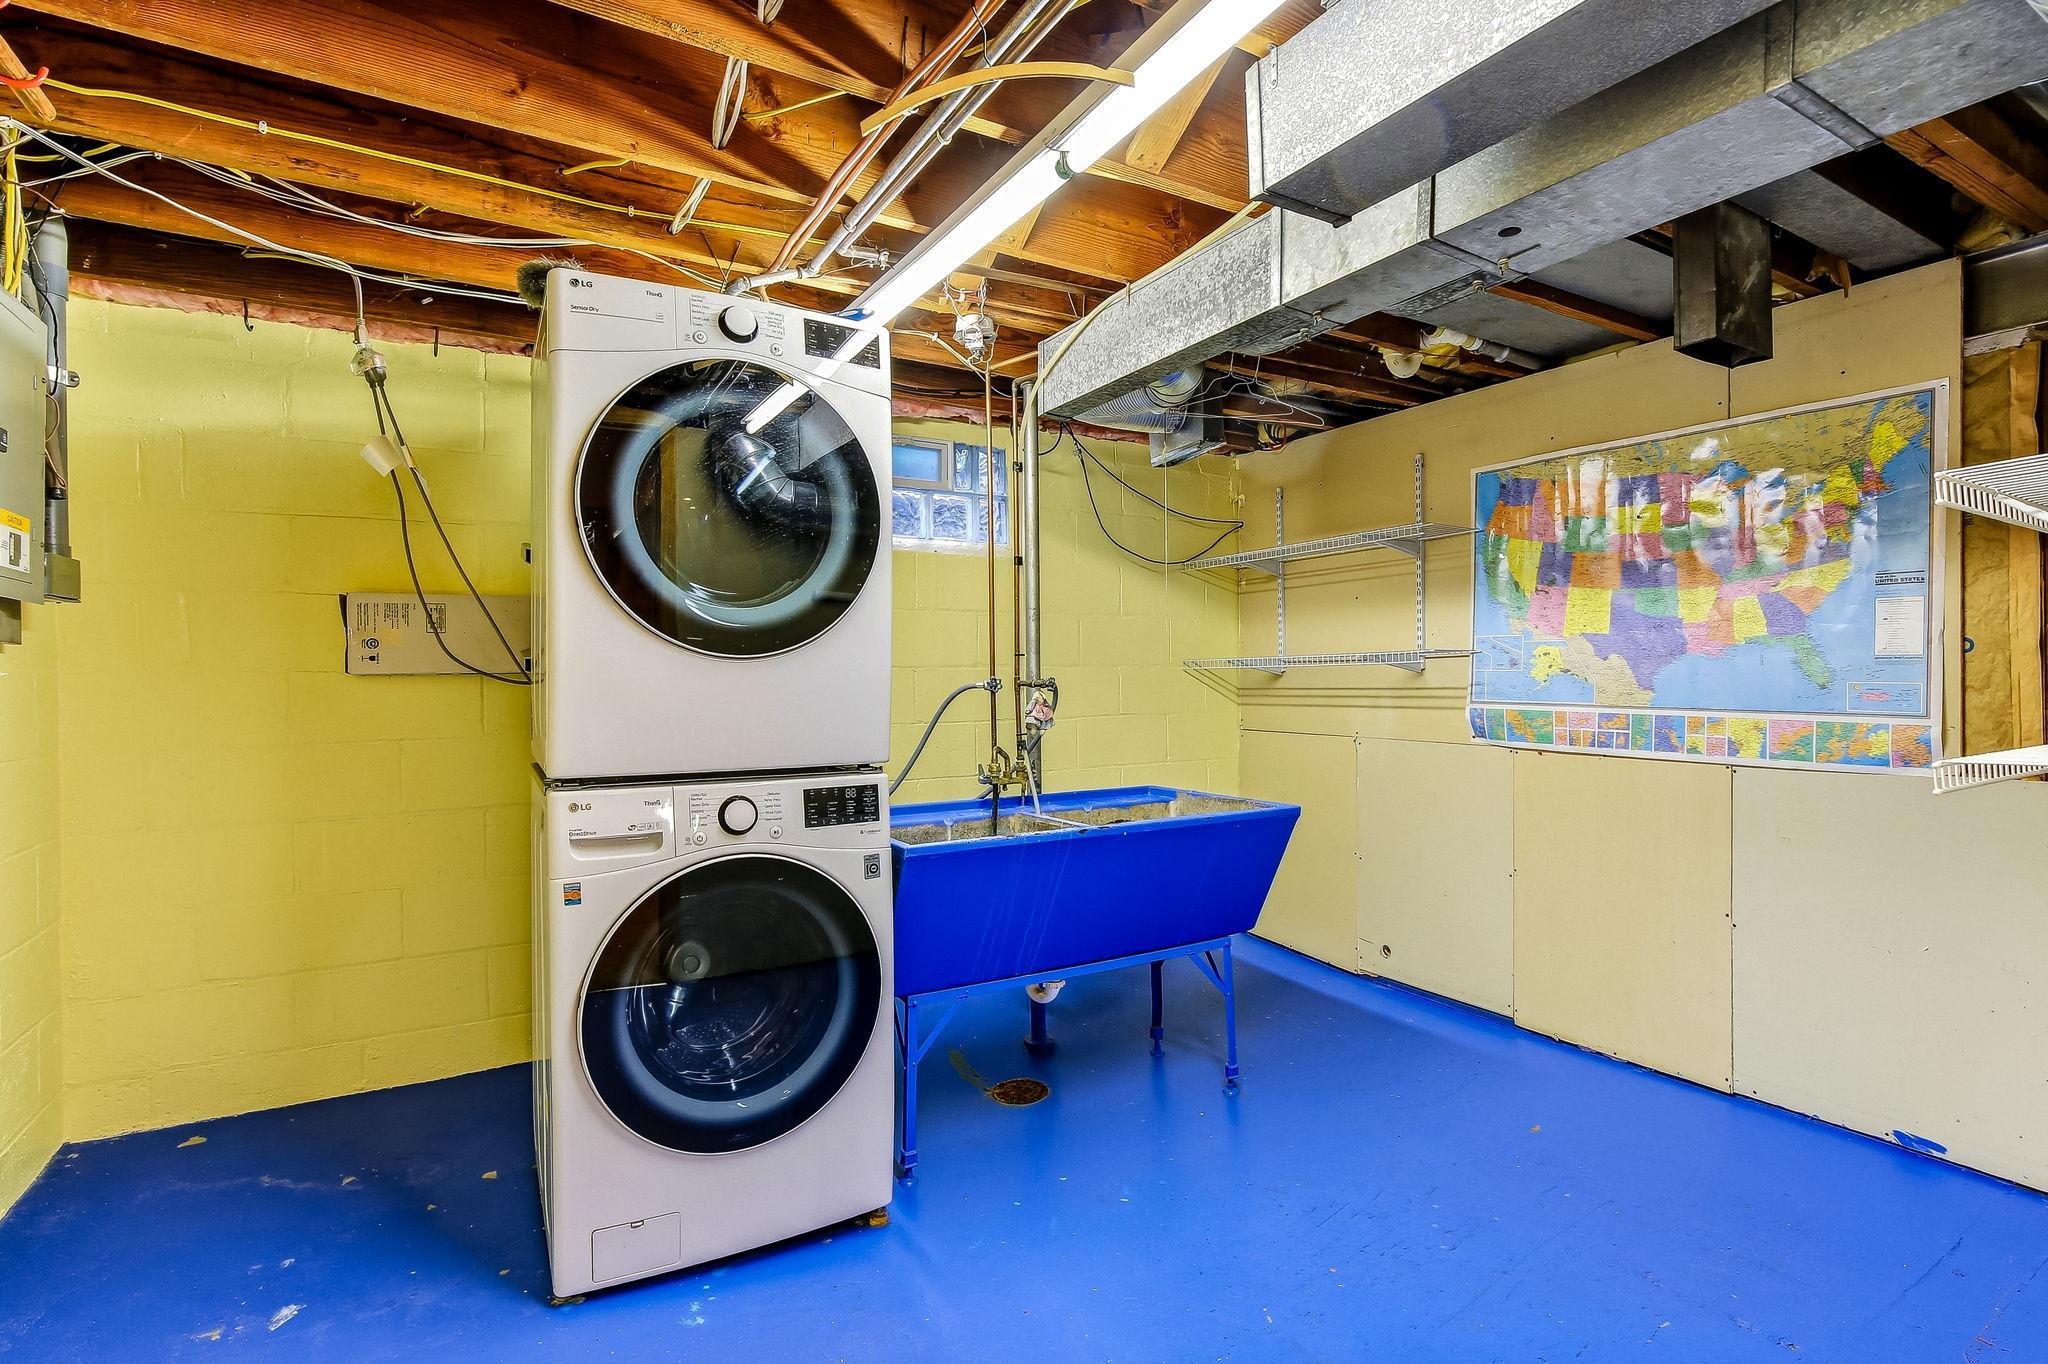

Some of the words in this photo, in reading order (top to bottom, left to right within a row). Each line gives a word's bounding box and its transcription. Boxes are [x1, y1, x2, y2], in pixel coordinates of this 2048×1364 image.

[581, 280, 593, 288] LG
[646, 290, 663, 298] ThinQ
[580, 803, 592, 811] LG
